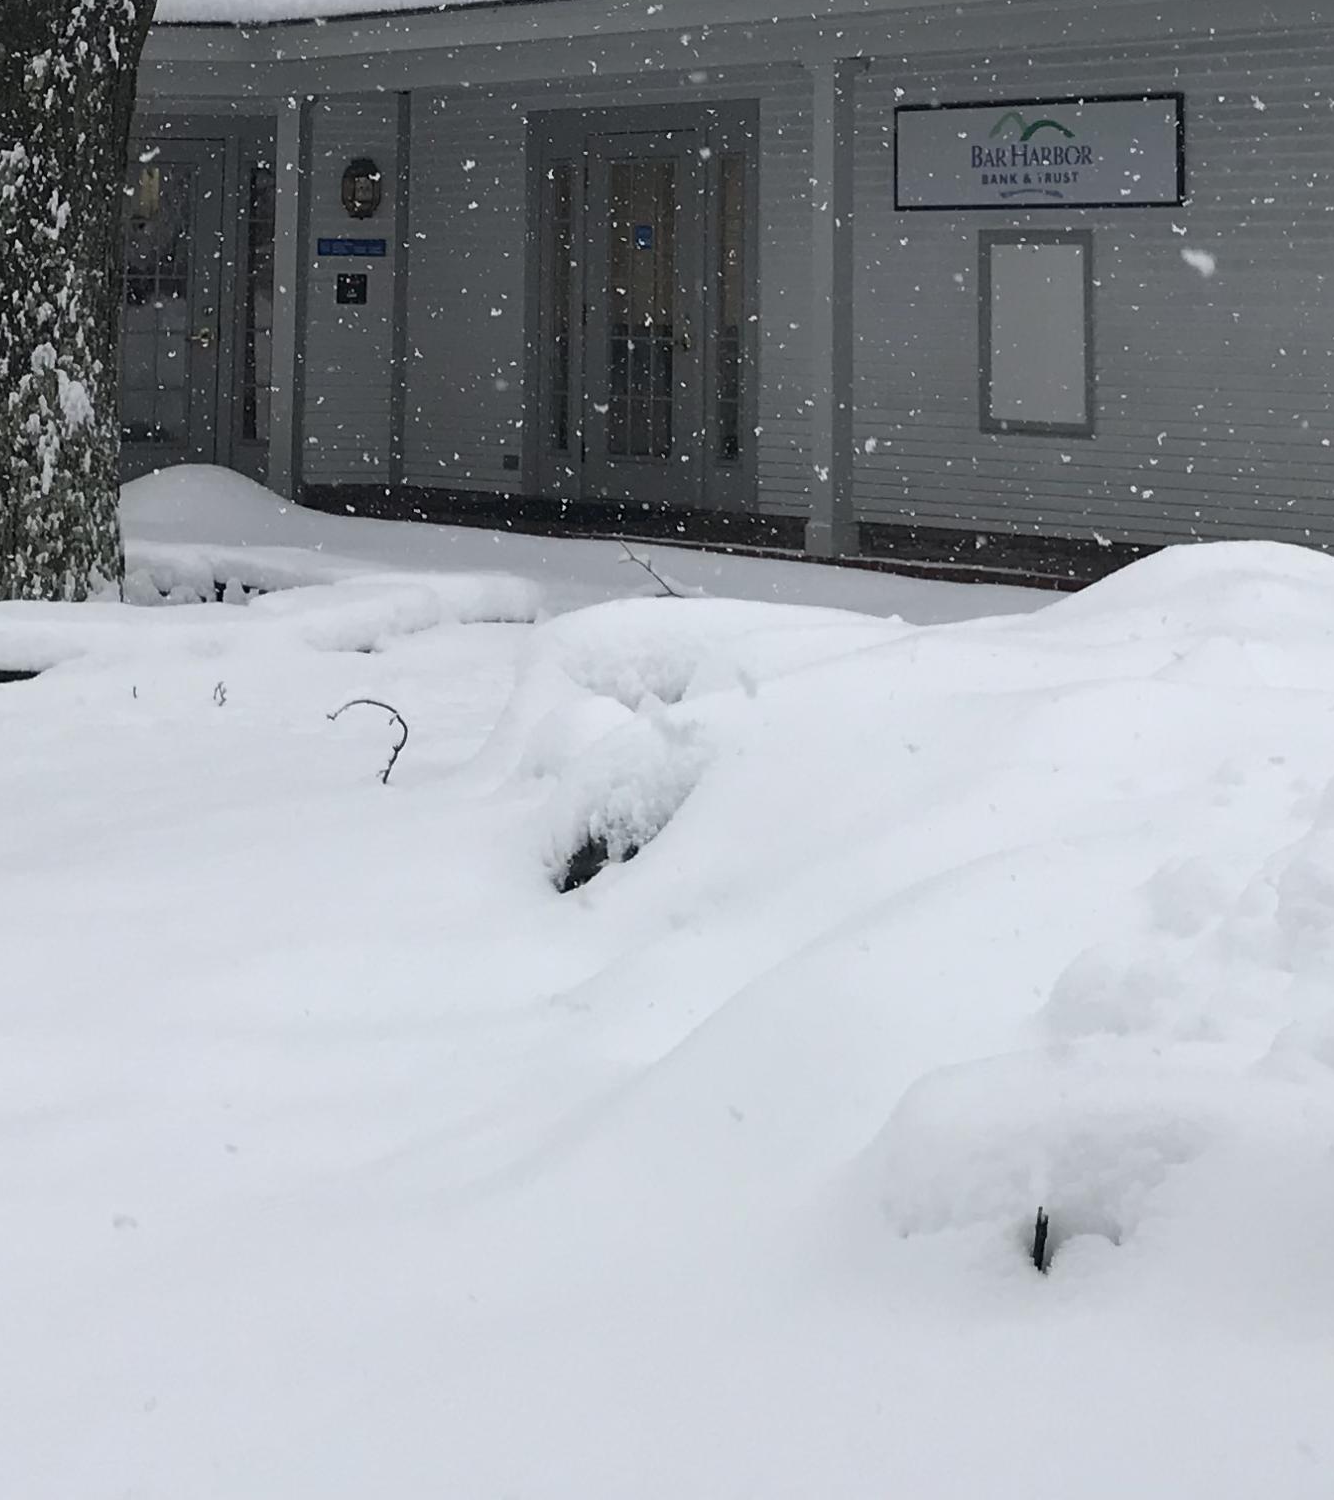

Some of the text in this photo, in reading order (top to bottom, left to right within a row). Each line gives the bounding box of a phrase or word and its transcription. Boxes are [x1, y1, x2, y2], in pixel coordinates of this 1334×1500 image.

[971, 144, 1093, 168] BAR HARBOR
[982, 173, 1018, 185] BANK
[1023, 173, 1032, 184] &
